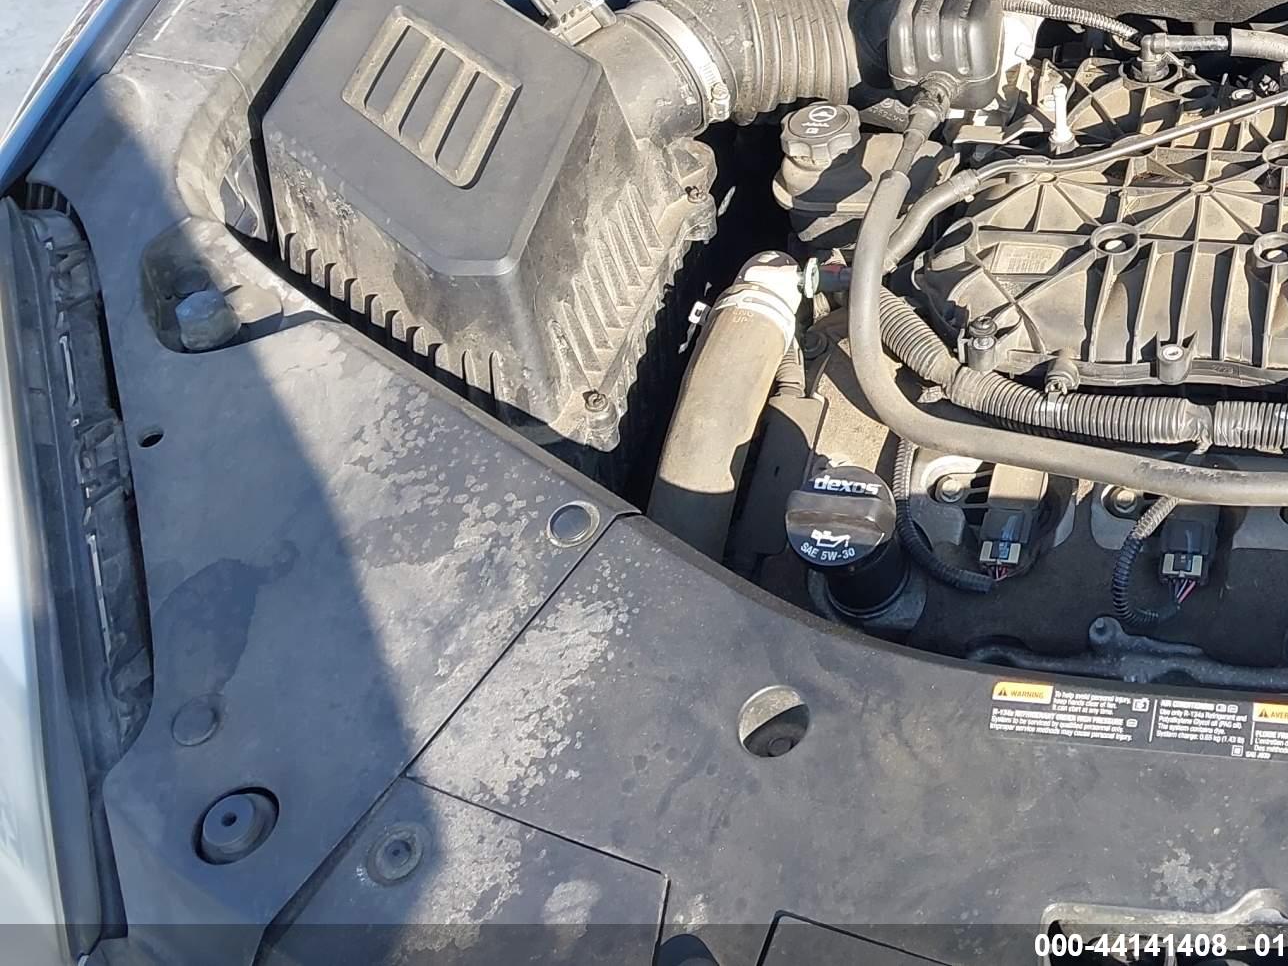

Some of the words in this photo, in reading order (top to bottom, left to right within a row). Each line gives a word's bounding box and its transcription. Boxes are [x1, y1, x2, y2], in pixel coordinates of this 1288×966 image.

[814, 475, 882, 495] dexos
[800, 542, 819, 558] SAE
[820, 548, 856, 561] 5W-30
[1010, 689, 1044, 698] WARNING
